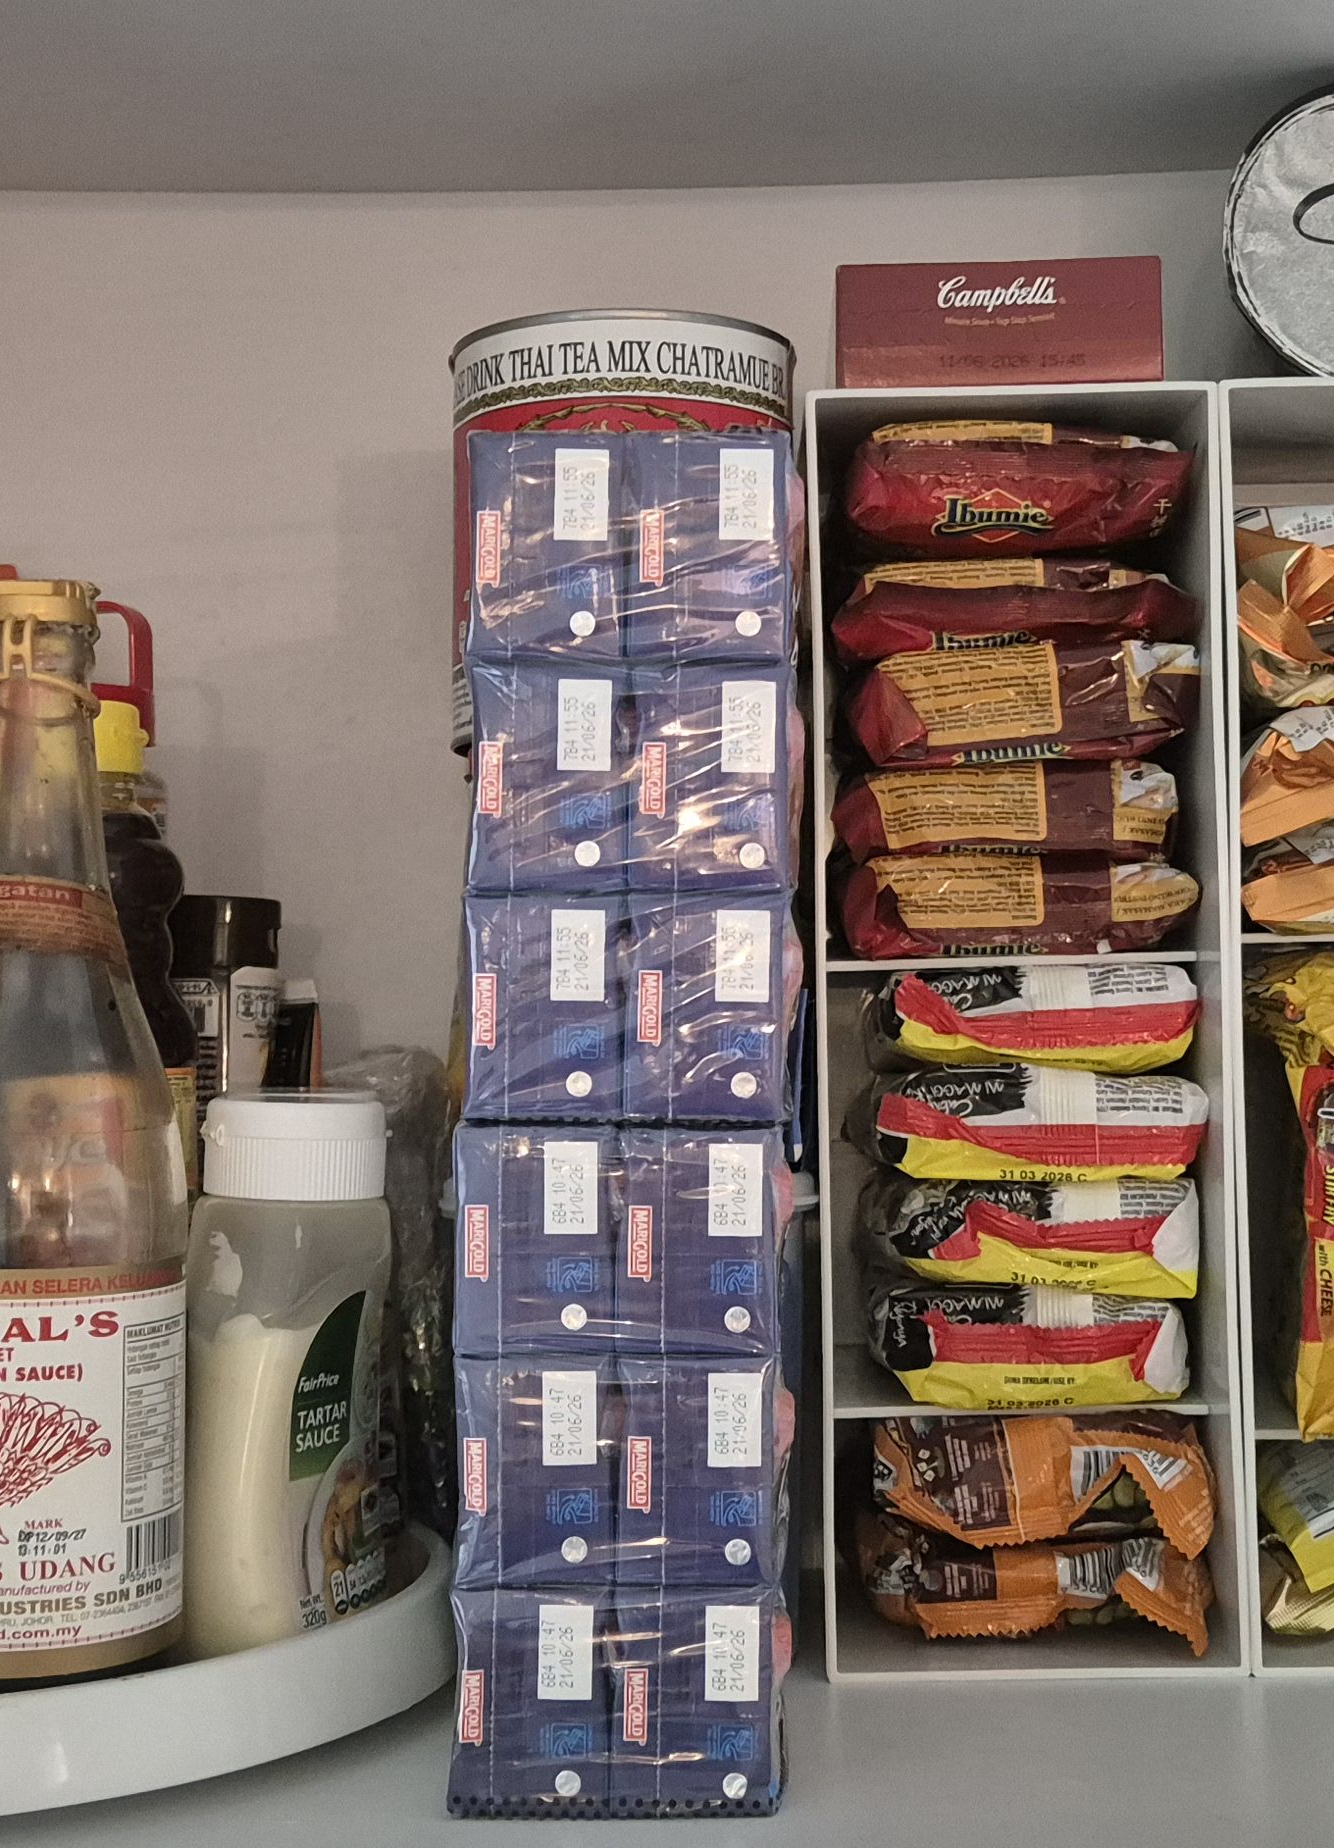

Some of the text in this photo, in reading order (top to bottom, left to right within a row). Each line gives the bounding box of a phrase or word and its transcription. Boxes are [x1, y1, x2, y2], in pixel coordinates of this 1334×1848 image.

[937, 276, 1058, 313] Campbell's
[468, 340, 771, 396] DRINK THAI TEA MIX CHATRAMUE
[935, 495, 1054, 536] Ibumie
[481, 515, 497, 579] MARIGOLD
[645, 514, 661, 578] MARIGOLD
[483, 745, 500, 810] MARIGOLD
[646, 746, 664, 811] MARIGOLD
[740, 931, 755, 990] 21/0626
[927, 975, 980, 991] MAGG
[476, 978, 494, 1042] MARIGOLD
[642, 974, 659, 1038] MARIGOLD
[999, 1167, 1015, 1179] 31
[1020, 1169, 1037, 1181] 03
[468, 1209, 485, 1273] MARIGOLD
[632, 1210, 649, 1273] MARIGOLD
[31, 1276, 102, 1295] SELERA
[1318, 1244, 1334, 1317] with CHEESE
[14, 1362, 84, 1382] SAUCE)
[298, 1372, 340, 1394] FairPrice
[295, 1423, 341, 1453] SAUCE
[297, 1400, 347, 1430] TARTAR
[468, 1442, 485, 1506] MARIGOLD
[631, 1440, 648, 1504] MARIGOLD
[24, 1518, 64, 1530] MARK
[19, 1552, 116, 1582] UDANG
[75, 1580, 91, 1594] by
[333, 1580, 345, 1598] 21
[94, 1588, 131, 1609] SDN
[135, 1578, 164, 1600] BHD
[301, 1608, 328, 1631] 320g
[463, 1674, 481, 1737] MARIGOLD
[628, 1672, 646, 1736] MARIGOLD
